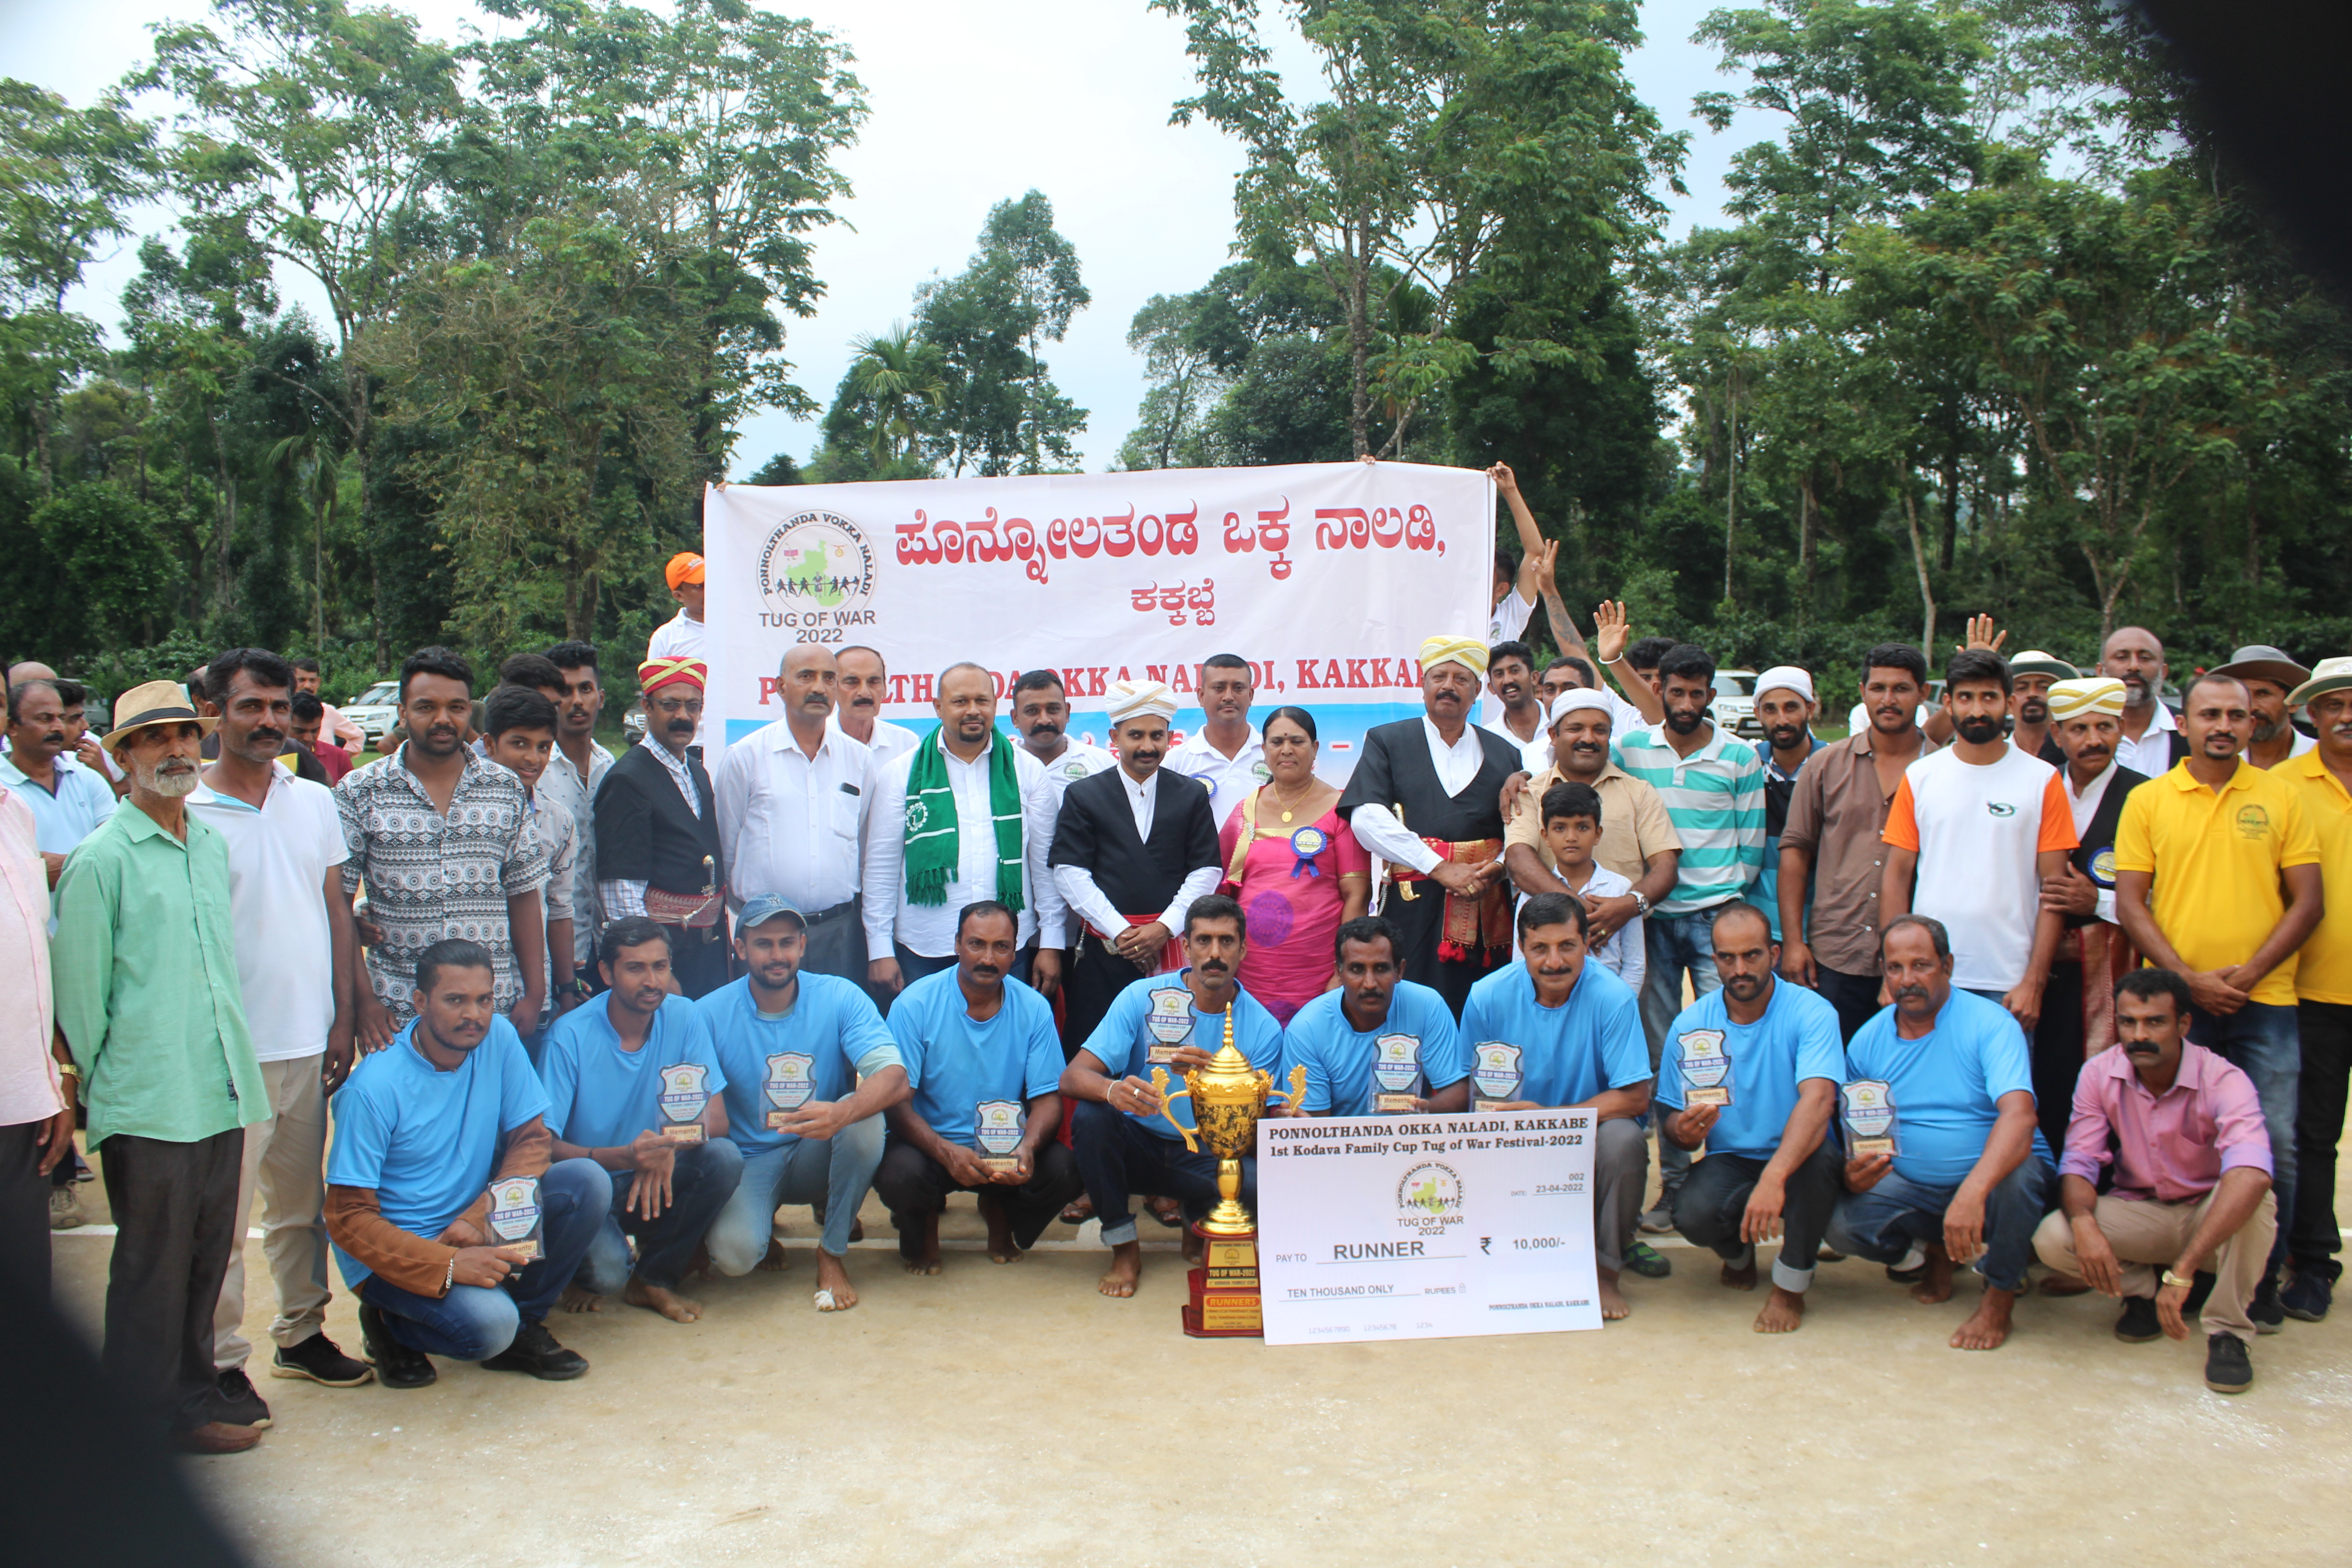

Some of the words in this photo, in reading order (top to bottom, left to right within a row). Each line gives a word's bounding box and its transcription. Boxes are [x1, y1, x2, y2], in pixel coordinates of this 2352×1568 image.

[1223, 495, 1292, 580] ಒಕ್ಕ
[1315, 504, 1446, 558] ನಾಲಡಿ,
[760, 513, 818, 596] PONNOLTHANDA
[823, 513, 862, 544] VOKKA
[860, 544, 873, 596] NALADI
[1131, 578, 1215, 626] ಕಕ್ಕಬ್ಬೆ
[759, 612, 798, 627] TUG
[803, 612, 828, 627] OF
[833, 610, 876, 626] WAR
[796, 628, 843, 643] 2022
[1269, 1125, 1394, 1140] PONNOLTHANDA
[1399, 1123, 1442, 1135] OKKA
[1448, 1121, 1509, 1133] NALADI,
[1514, 1118, 1589, 1131] KAKKABE
[1270, 1146, 1289, 1156] 1st
[1293, 1144, 1341, 1156] Kodava
[1346, 1143, 1389, 1156] Family
[1393, 1142, 1418, 1154] Cup
[1422, 1140, 1446, 1153] Tug
[1450, 1139, 1463, 1149] of
[1466, 1139, 1491, 1149] War
[1496, 1135, 1583, 1149] Festival-2022
[1435, 1162, 1458, 1179] VOKKA
[1536, 1183, 1583, 1193] 23-04-2022
[511, 1208, 535, 1217] WAR-2022
[1397, 1218, 1419, 1228] TUG
[1422, 1217, 1436, 1226] OF
[1439, 1215, 1464, 1225] WAR
[1418, 1226, 1446, 1236] 2022
[503, 1245, 532, 1253] emento
[1513, 1237, 1566, 1251] 10,000/-
[1276, 1254, 1292, 1263] PAY
[1296, 1254, 1307, 1262] TO
[1334, 1241, 1425, 1260] RUNNER
[1287, 1289, 1307, 1298] TEN
[1309, 1286, 1365, 1297] THOUSAND
[1368, 1284, 1394, 1294] ONLY
[1425, 1287, 1456, 1295] RUPEES
[1210, 1298, 1256, 1306] RUNNERS
